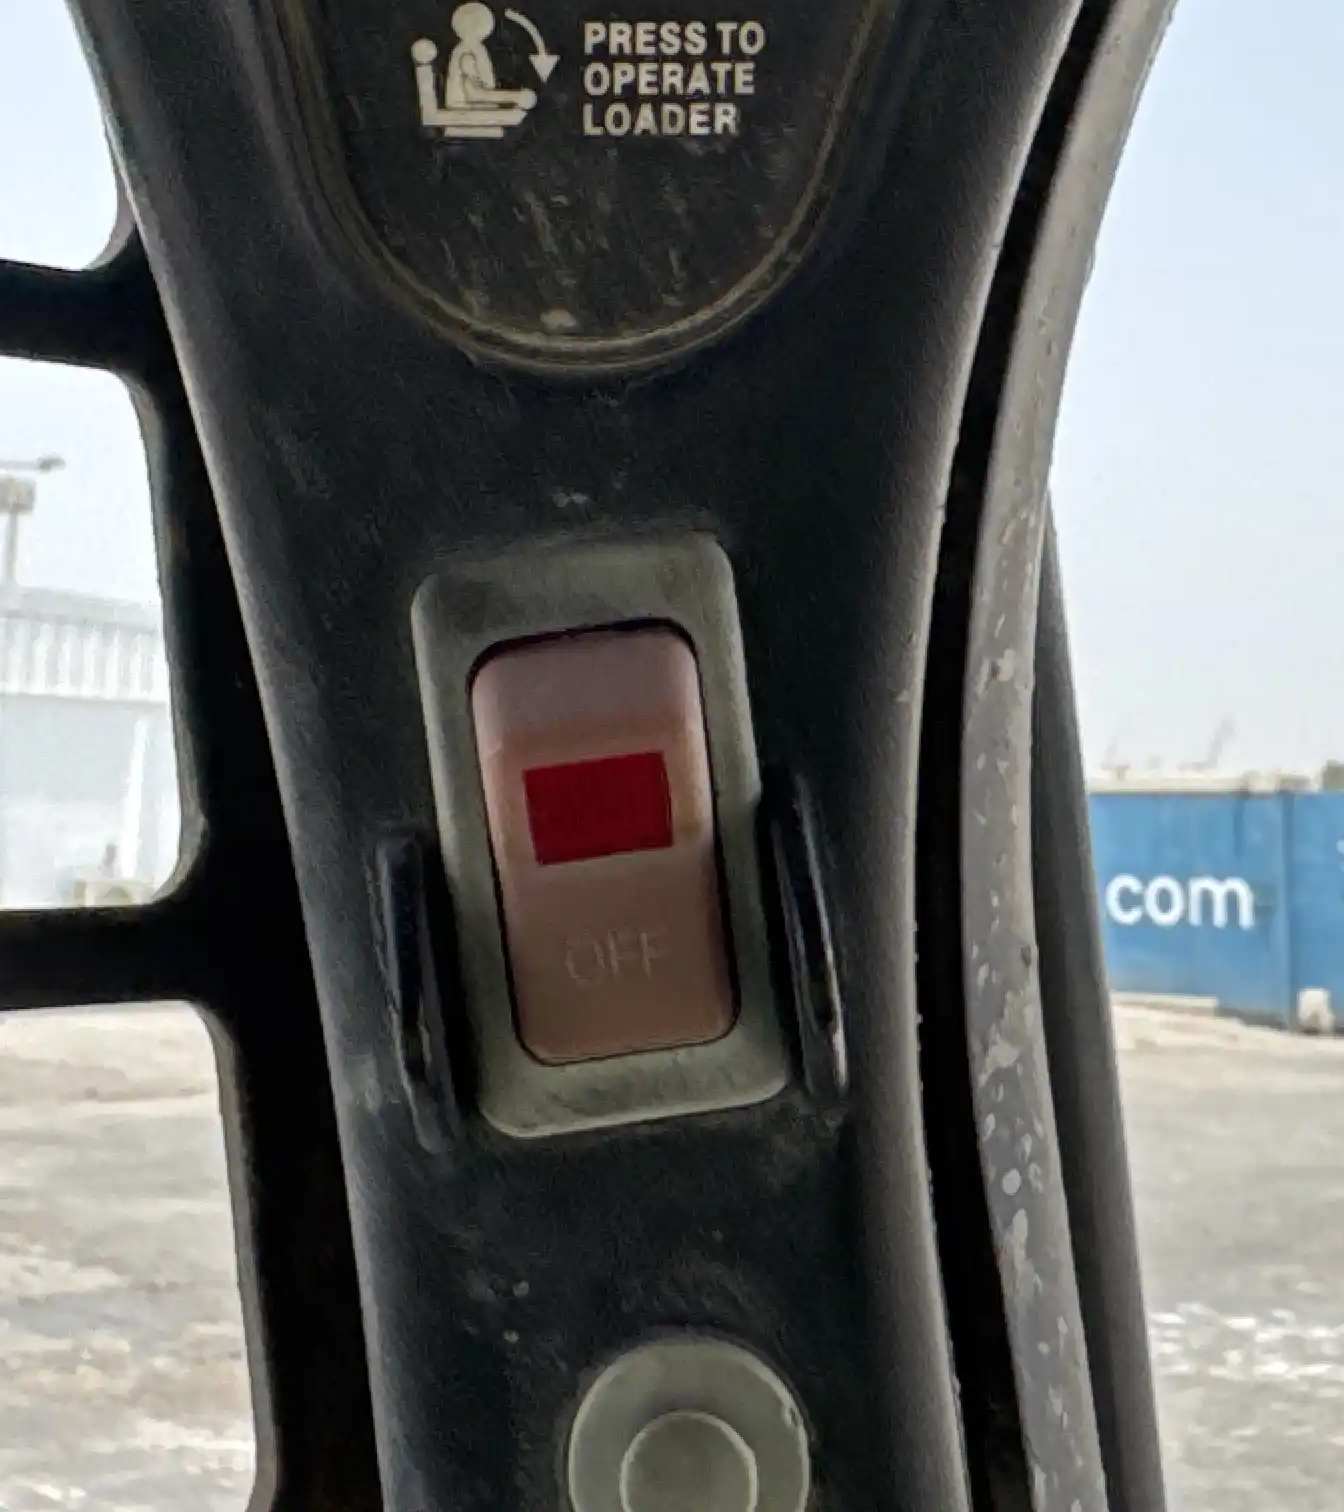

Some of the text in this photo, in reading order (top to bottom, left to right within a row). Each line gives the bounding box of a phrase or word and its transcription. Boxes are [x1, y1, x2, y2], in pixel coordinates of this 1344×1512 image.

[583, 21, 766, 55] PRESS TO
[583, 62, 757, 96] OPERATE
[583, 103, 739, 137] LOADER
[564, 922, 672, 990] OFF
